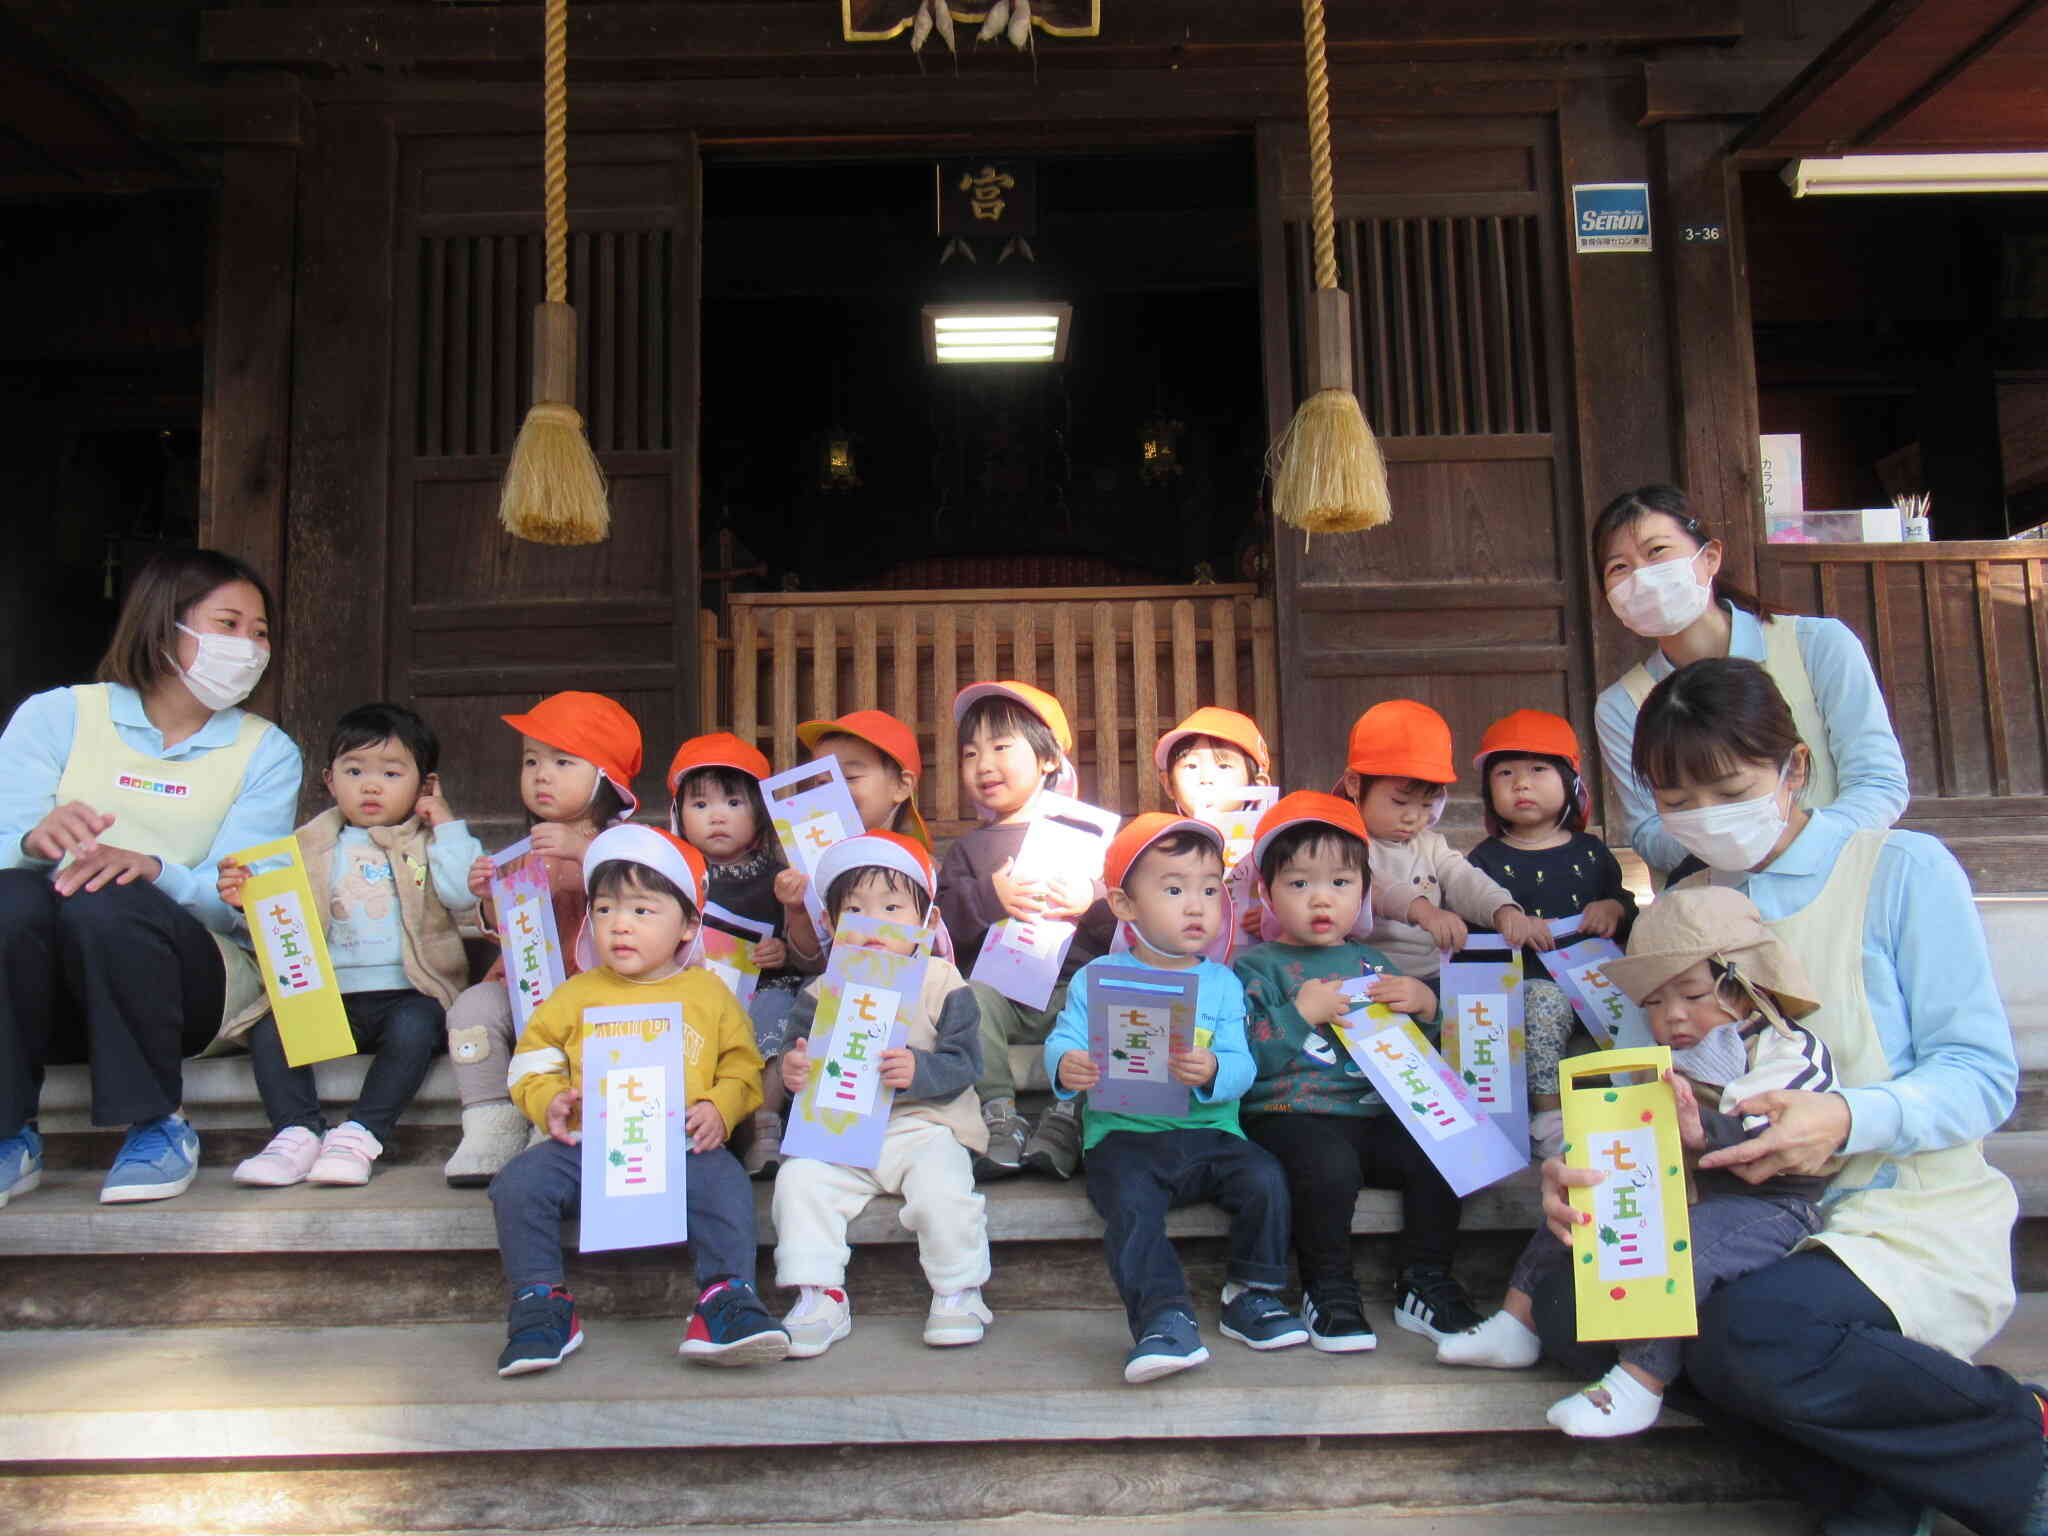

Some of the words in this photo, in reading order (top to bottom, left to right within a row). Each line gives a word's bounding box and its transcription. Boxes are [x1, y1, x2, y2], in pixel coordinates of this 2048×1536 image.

[960, 165, 1015, 221] 宮
[1685, 227, 1720, 240] 3-36
[269, 904, 309, 989] 七五三
[515, 911, 545, 1007] 七五三
[836, 993, 878, 1101] 七五三
[1120, 1010, 1152, 1074] 七五三
[1374, 1040, 1457, 1127] 七五三
[1468, 1000, 1496, 1103] 七五三
[617, 1075, 649, 1184] 七五三
[1601, 1140, 1643, 1266] 七五三
